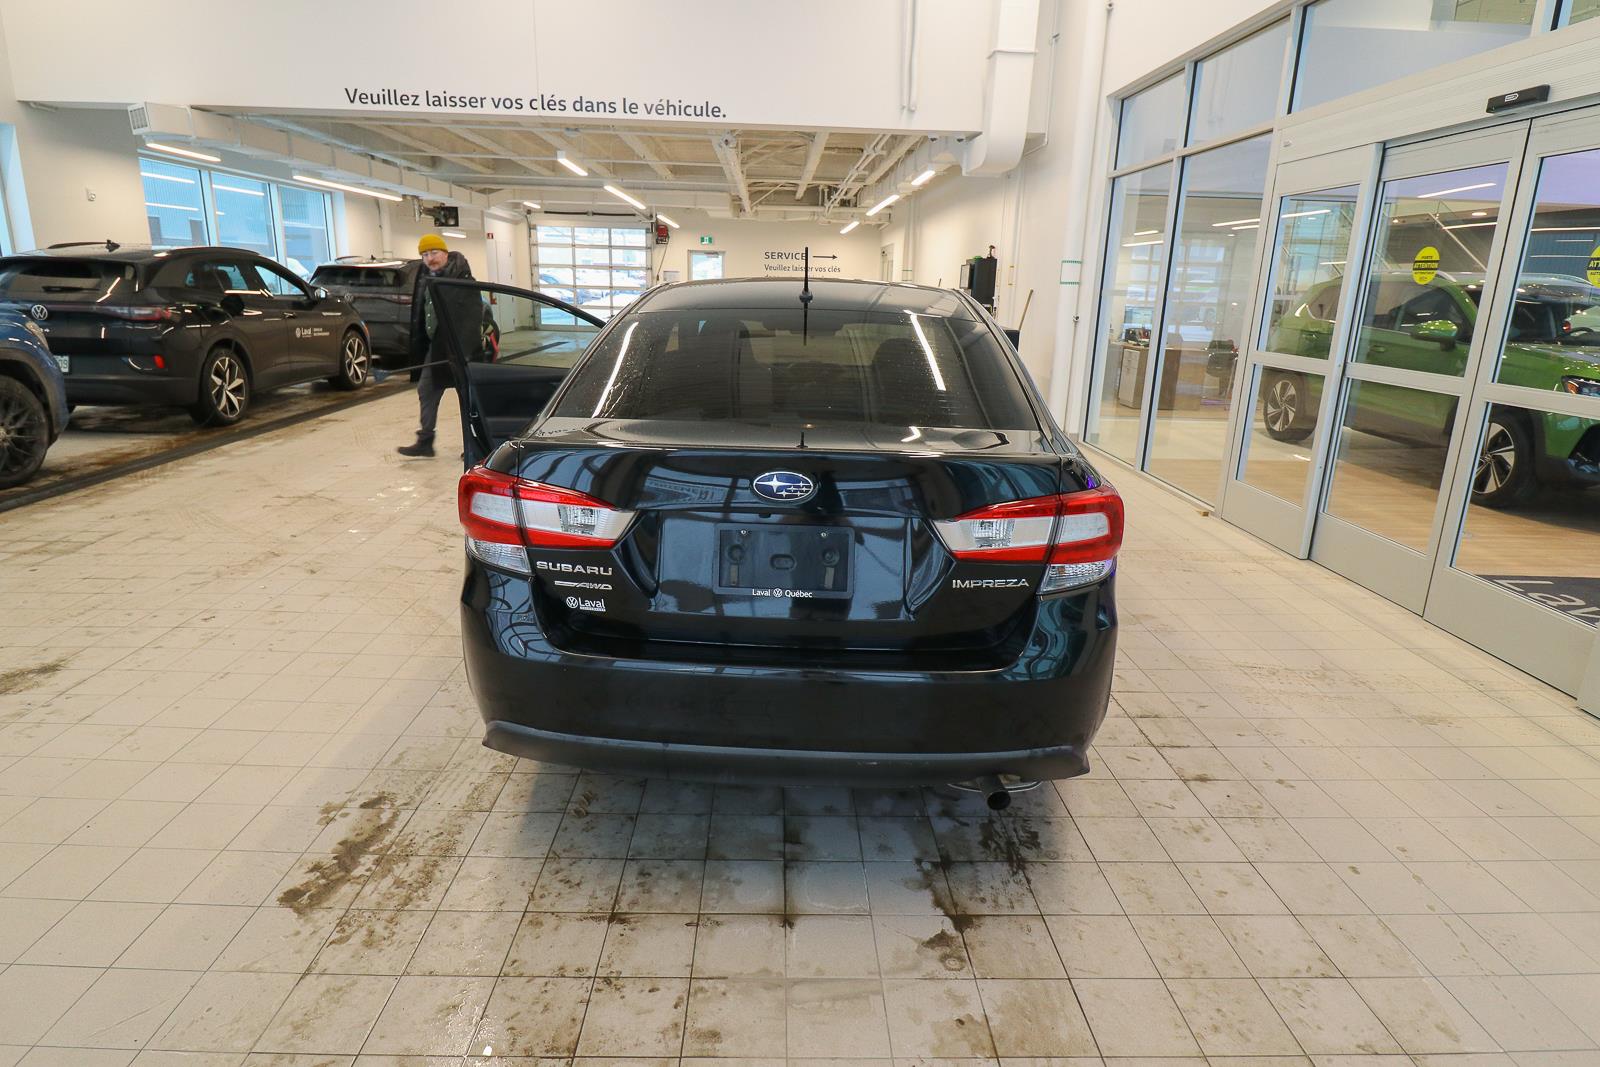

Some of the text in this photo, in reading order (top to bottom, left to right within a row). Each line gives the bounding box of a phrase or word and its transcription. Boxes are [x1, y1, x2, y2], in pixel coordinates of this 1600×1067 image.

[344, 87, 727, 118] Veuillez laisser vos clés dans le véhicule.
[764, 251, 807, 261] SERVICE
[764, 264, 790, 272] Veuillez
[791, 264, 814, 273] laiser
[536, 561, 613, 576] SUBARU
[952, 578, 1030, 589] IMPREZA
[752, 588, 771, 597] Laval
[784, 589, 813, 598] Québec
[578, 597, 606, 609] Laval
